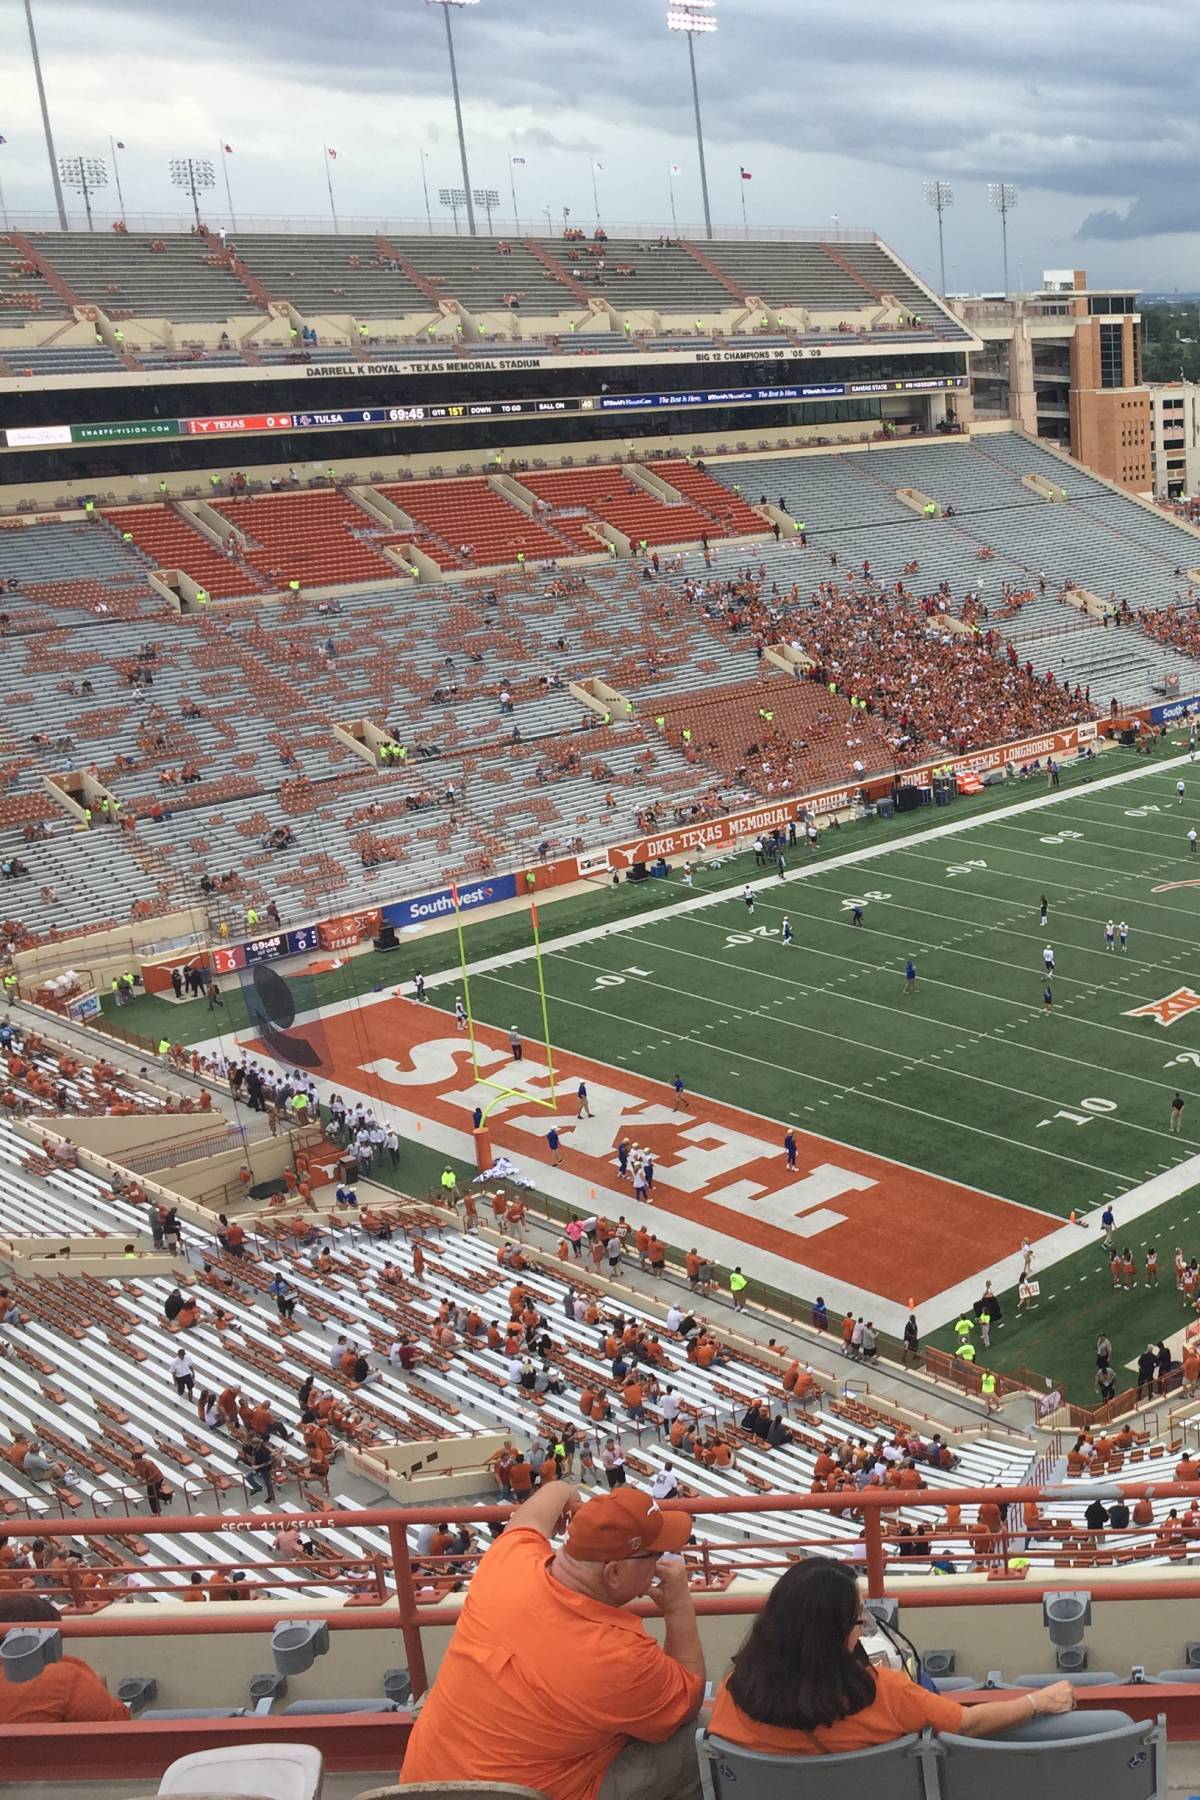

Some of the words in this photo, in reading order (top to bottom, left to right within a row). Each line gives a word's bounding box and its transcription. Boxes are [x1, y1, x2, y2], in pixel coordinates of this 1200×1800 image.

[696, 353, 710, 361] BIG
[712, 353, 722, 361] 12
[724, 351, 770, 360] CHAMPIONS
[306, 365, 355, 376] DARRELL
[357, 365, 365, 374] K
[368, 364, 400, 374] ROYAL
[410, 362, 444, 372] TEXAS
[446, 360, 497, 371] MEMORIAL
[499, 359, 541, 369] STADIUM
[389, 408, 424, 420] 69:45
[448, 407, 464, 417] 1ST
[471, 406, 492, 414] DOWN
[501, 405, 510, 413] TO
[213, 420, 245, 429] TEXAS
[266, 416, 275, 427] 0
[313, 414, 343, 424] TULSA
[362, 411, 371, 421] 0
[81, 425, 170, 437] SHARPE-VISION.COM
[1003, 738, 1055, 761] LONGHORNS
[647, 823, 723, 858] DKR-TEXAS
[729, 807, 792, 836] MEMORIAL
[251, 937, 281, 952] 69:45
[330, 936, 358, 950] TEXAS
[1052, 1096, 1118, 1127] 10
[357, 1037, 880, 1239] TEXAS
